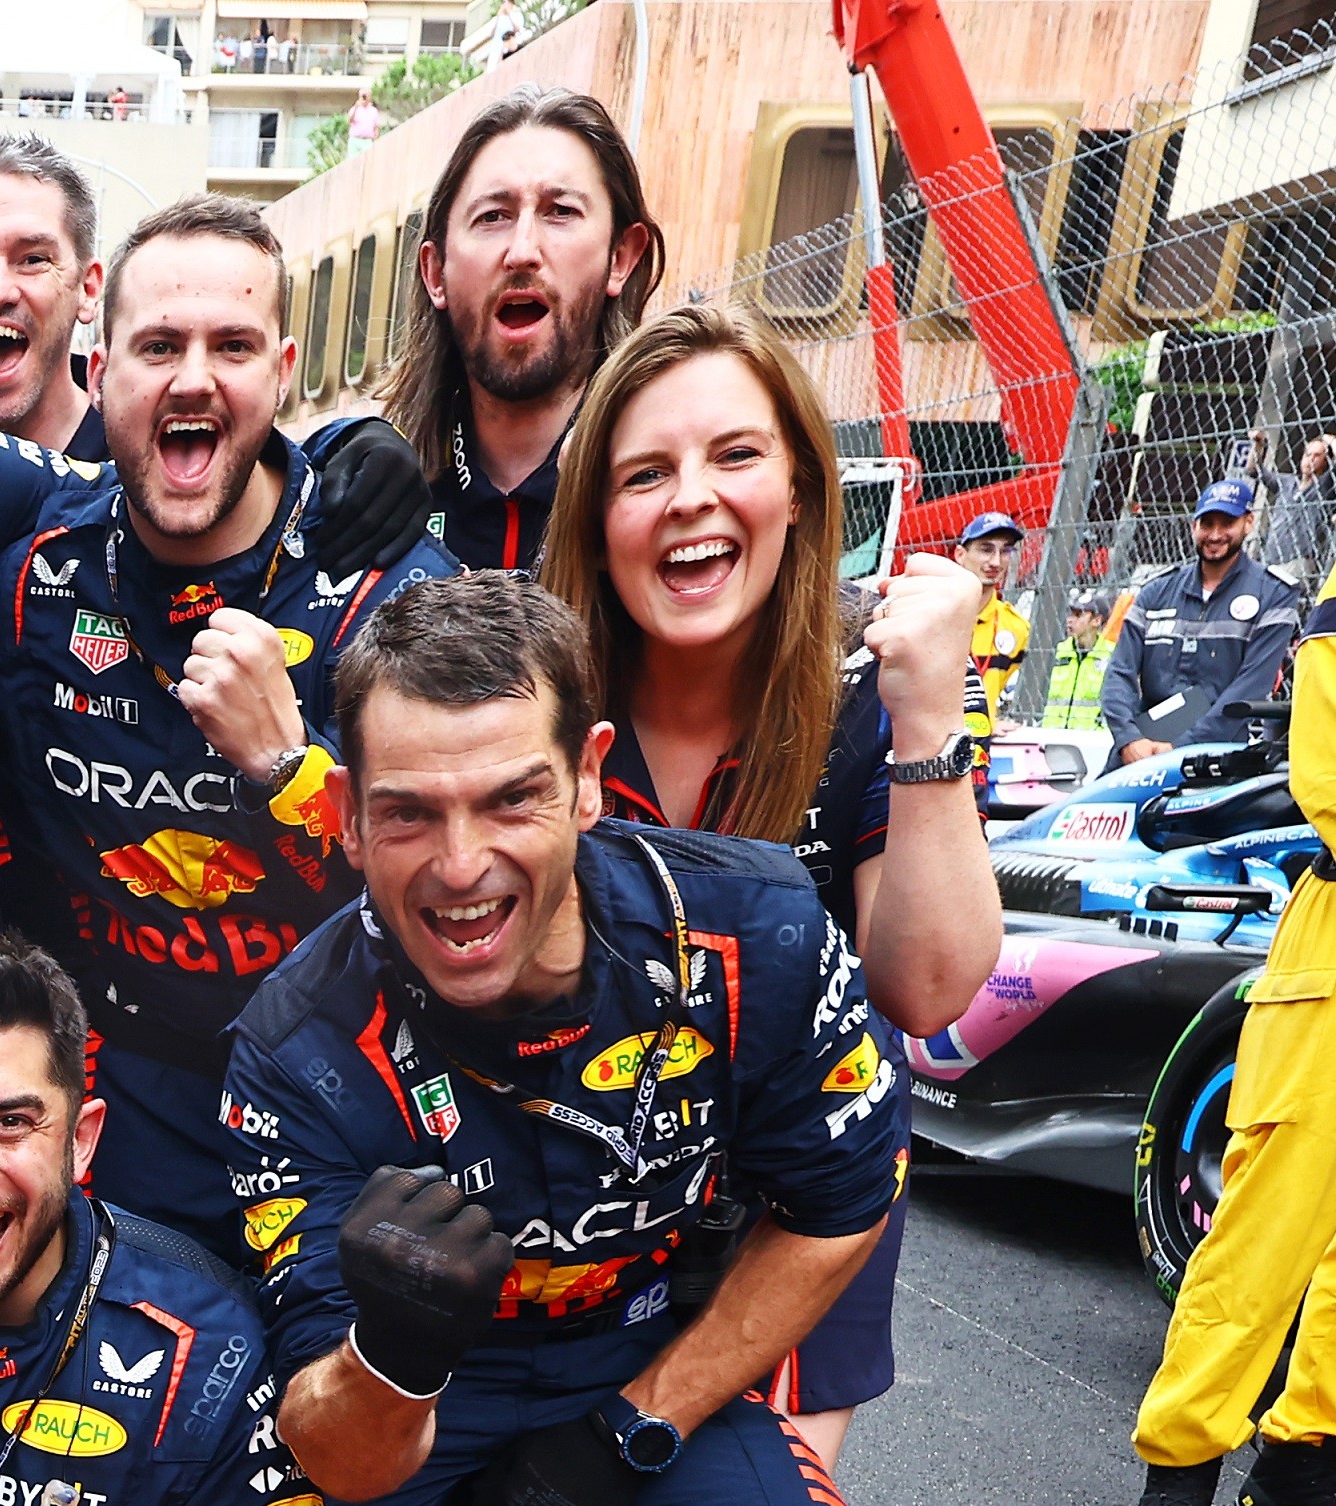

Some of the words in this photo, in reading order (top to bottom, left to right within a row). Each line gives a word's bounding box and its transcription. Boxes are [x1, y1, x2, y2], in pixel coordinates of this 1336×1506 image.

[169, 606, 195, 625] Red
[195, 597, 224, 620] Bull
[73, 638, 129, 666] HEUER
[54, 682, 114, 719] Mobil
[45, 748, 237, 813] ORAC
[1066, 805, 1128, 843] Castrol
[1235, 828, 1320, 850] ALPINECA
[1195, 898, 1235, 910] Castrol
[987, 974, 1033, 989] CHANGE
[995, 988, 1037, 1000] WORLD
[617, 1034, 697, 1075] RACH
[638, 1050, 666, 1109] ACCESS
[552, 1105, 605, 1134] ACCESS
[90, 1251, 107, 1286] 2023
[93, 1381, 152, 1399] CASTORE
[182, 1334, 250, 1438] sparco
[33, 1413, 110, 1445] RAUCH
